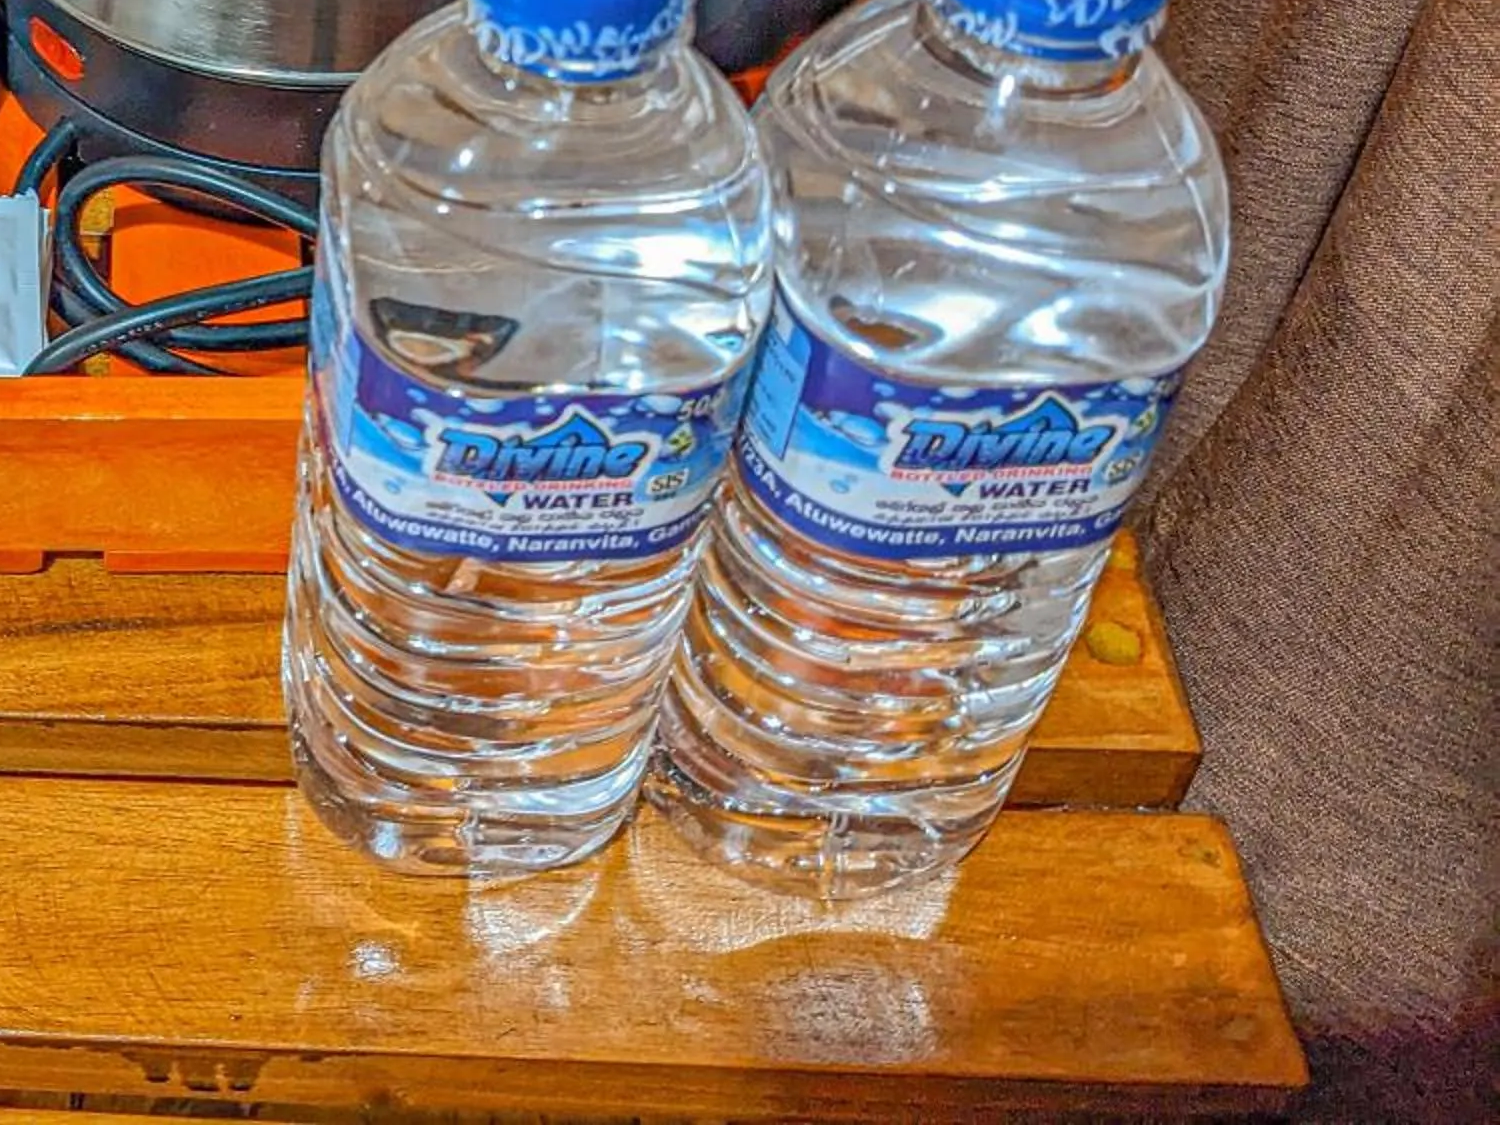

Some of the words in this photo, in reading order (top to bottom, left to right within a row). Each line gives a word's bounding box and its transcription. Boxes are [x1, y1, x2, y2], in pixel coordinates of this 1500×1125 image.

[437, 420, 646, 482] Divine
[893, 405, 1115, 469] Divine
[521, 491, 634, 510] WATER
[977, 478, 1091, 500] WATER
